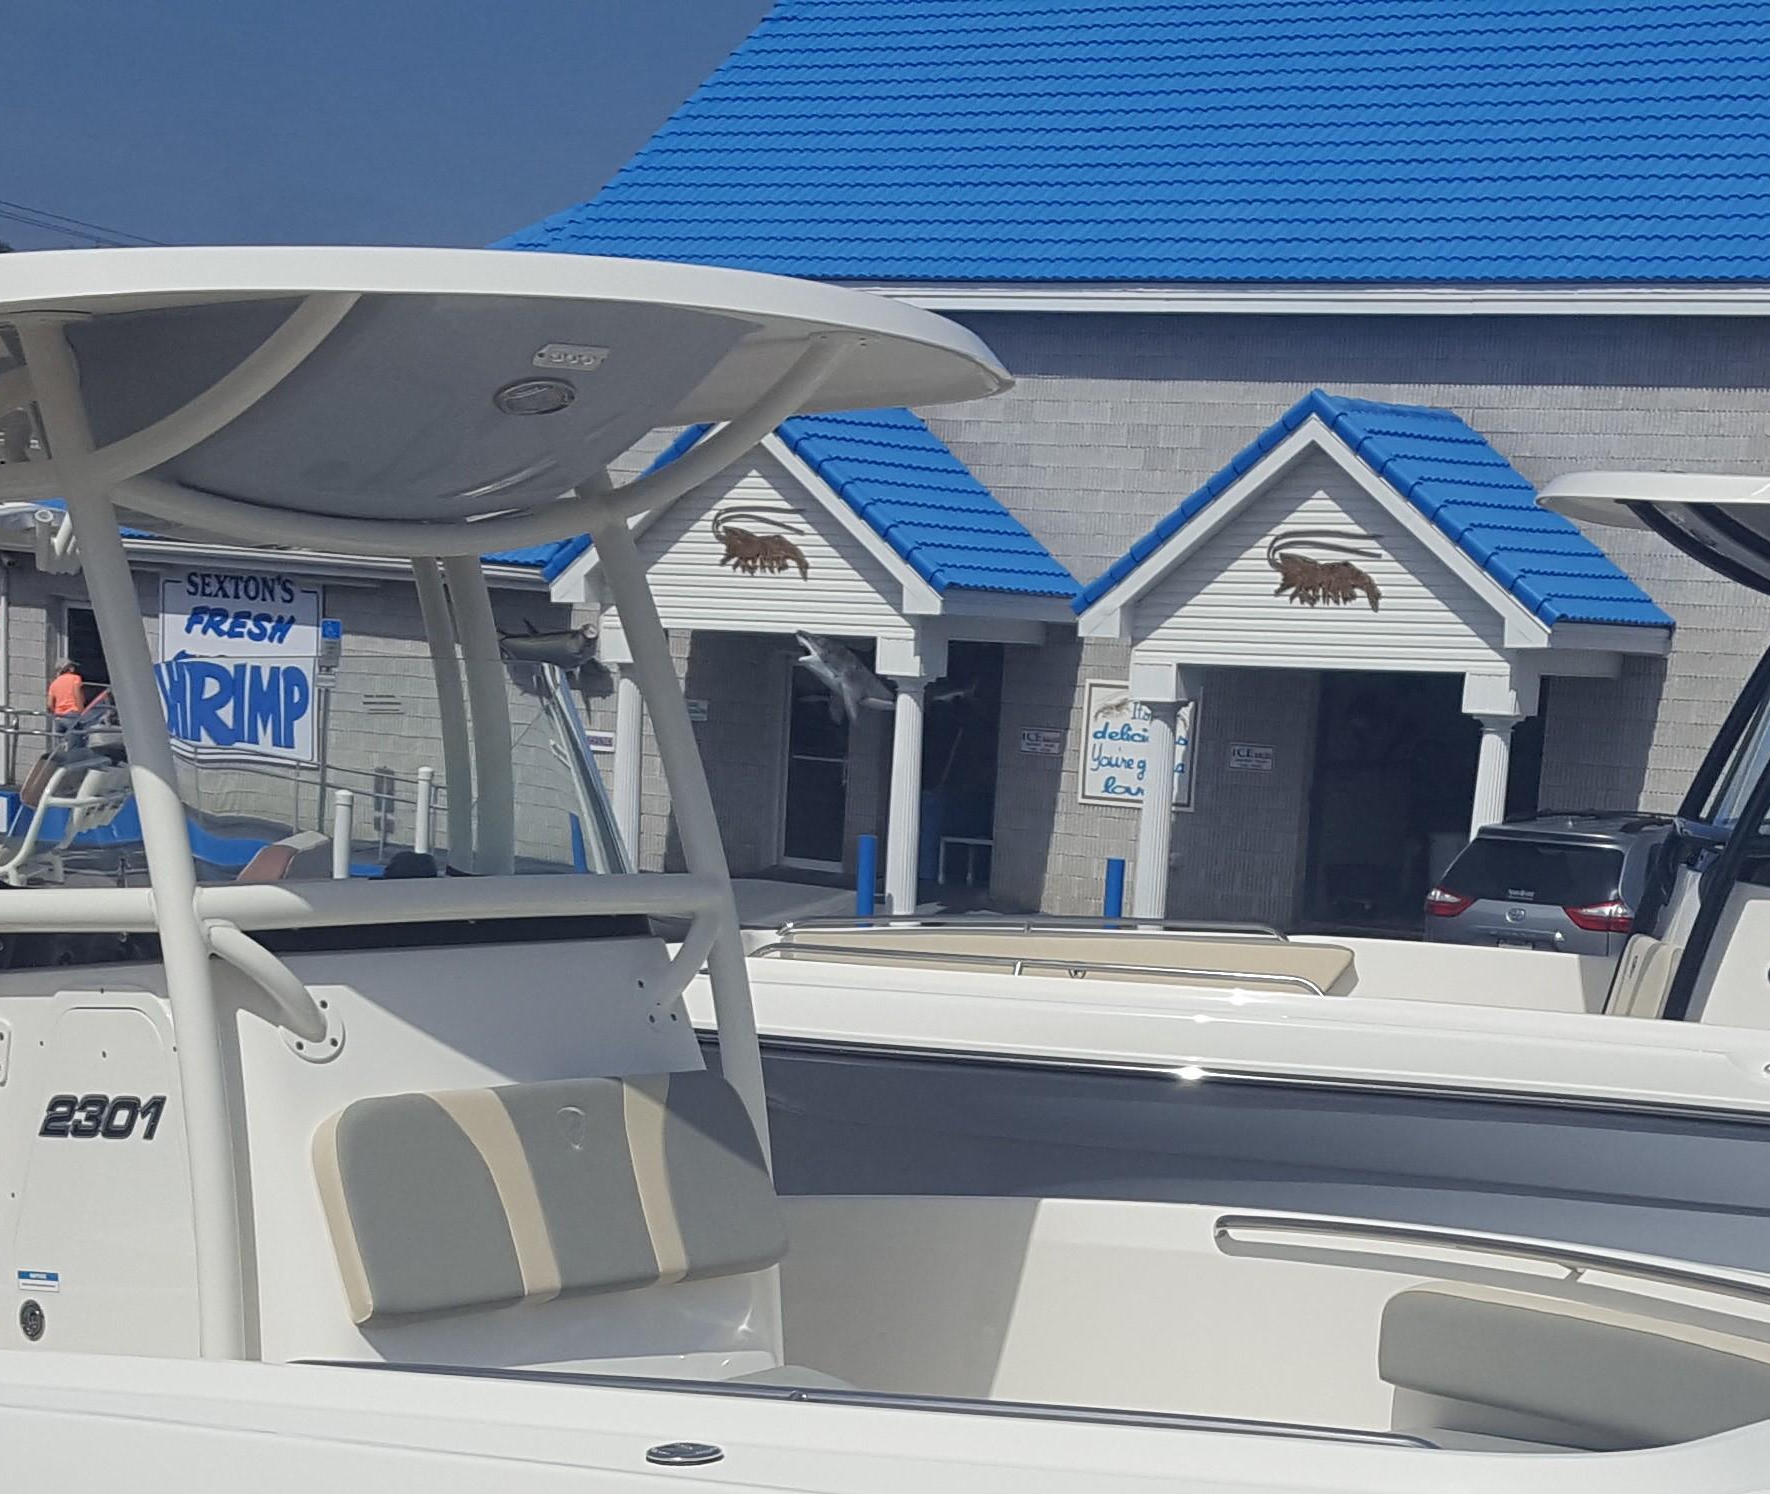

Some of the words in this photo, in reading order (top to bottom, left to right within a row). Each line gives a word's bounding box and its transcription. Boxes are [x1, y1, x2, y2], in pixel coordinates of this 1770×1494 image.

[186, 571, 296, 604] SEXTON'S
[184, 605, 297, 645] FRESH
[154, 650, 310, 749] HRIMP
[37, 1093, 168, 1141] 2301
